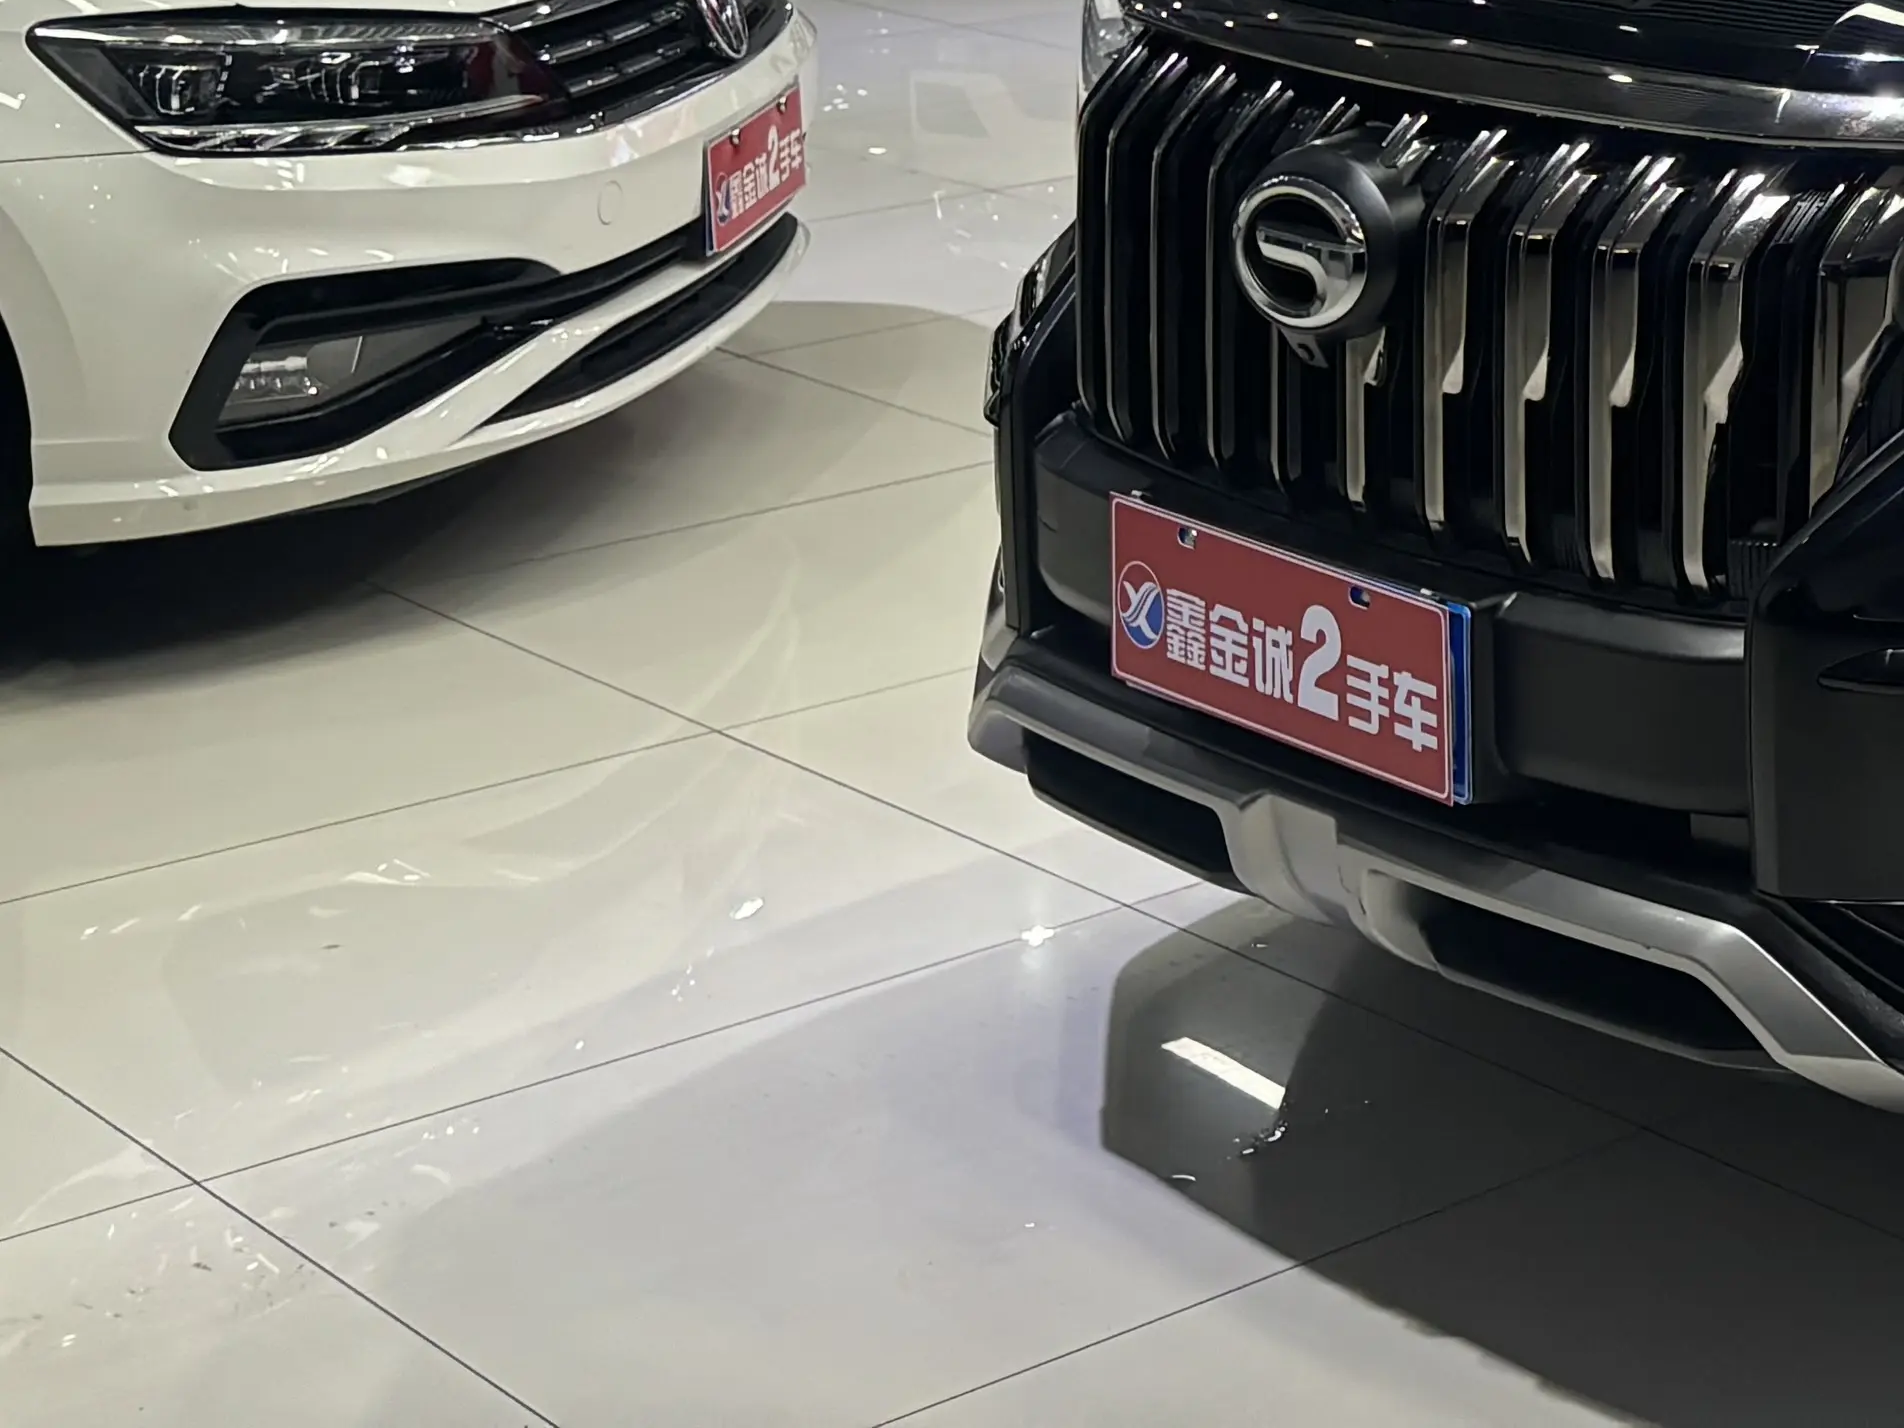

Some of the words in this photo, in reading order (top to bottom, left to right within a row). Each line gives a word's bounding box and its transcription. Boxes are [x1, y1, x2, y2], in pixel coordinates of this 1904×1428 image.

[729, 124, 803, 219] 鑫金诚2手车
[1166, 588, 1439, 753] 鑫金诚2手车
